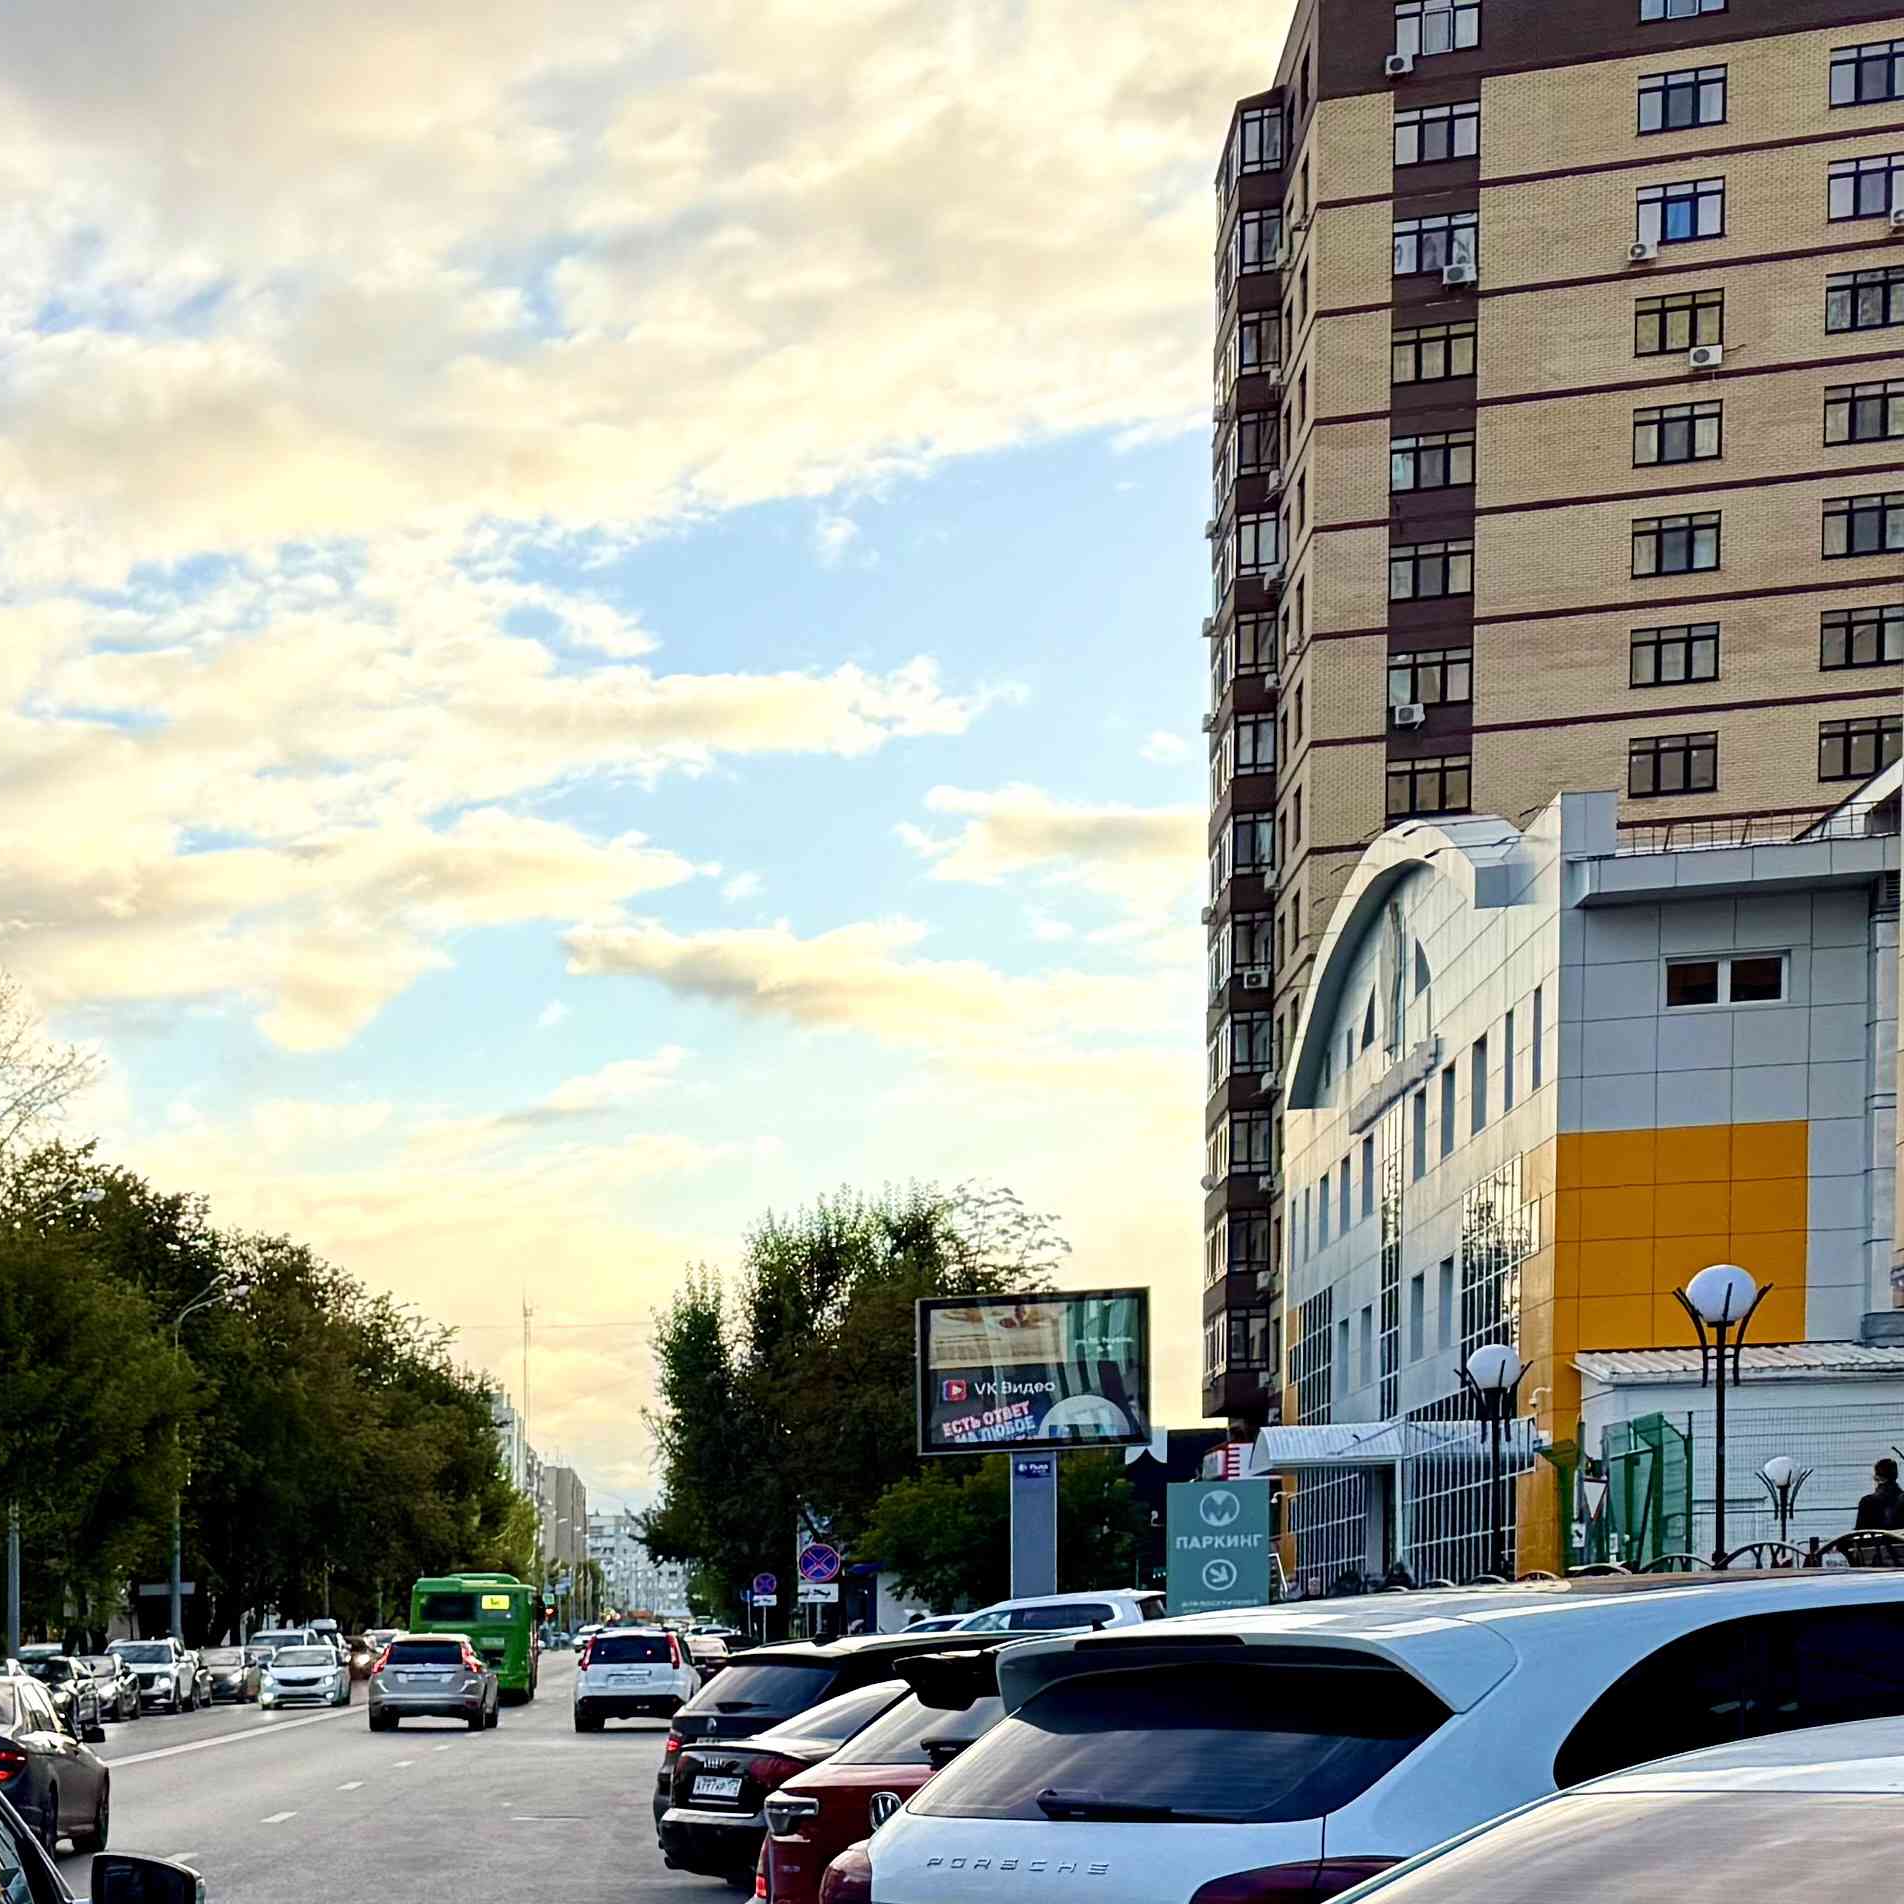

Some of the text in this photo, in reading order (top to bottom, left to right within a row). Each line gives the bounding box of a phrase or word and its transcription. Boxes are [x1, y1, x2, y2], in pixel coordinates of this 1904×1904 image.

[974, 1381, 1056, 1396] VK Видео
[942, 1400, 1030, 1437] ЕСТЬ ОТВЕТ
[1175, 1534, 1264, 1550] ПАРКИНГ
[927, 1857, 1110, 1876] PORSCHE
